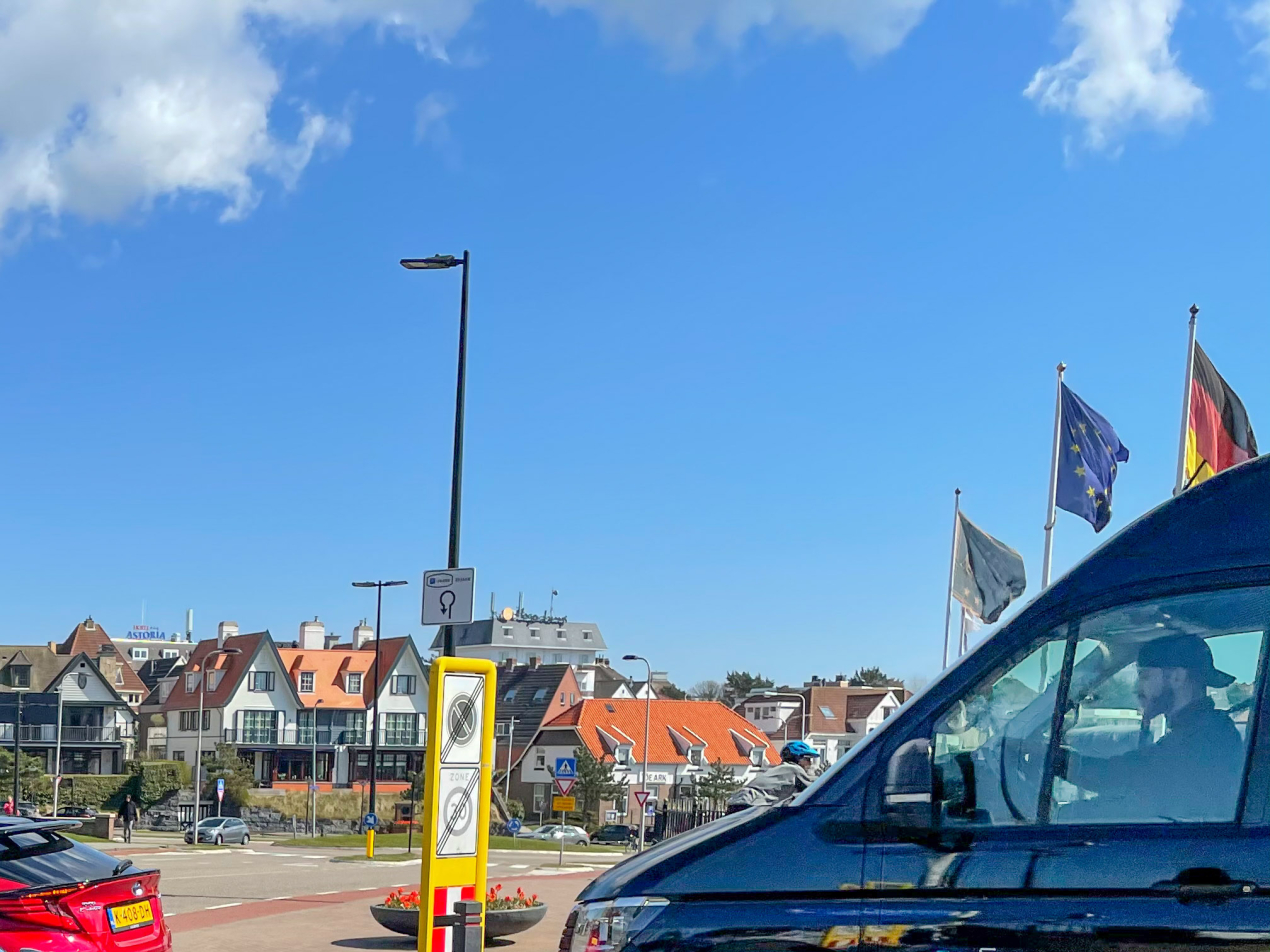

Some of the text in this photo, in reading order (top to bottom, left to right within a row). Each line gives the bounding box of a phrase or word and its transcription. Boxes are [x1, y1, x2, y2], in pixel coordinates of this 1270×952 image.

[126, 630, 166, 640] ASTORIA
[450, 772, 471, 781] ZONE
[654, 773, 667, 782] ARK
[114, 904, 151, 925] K-408-DH
